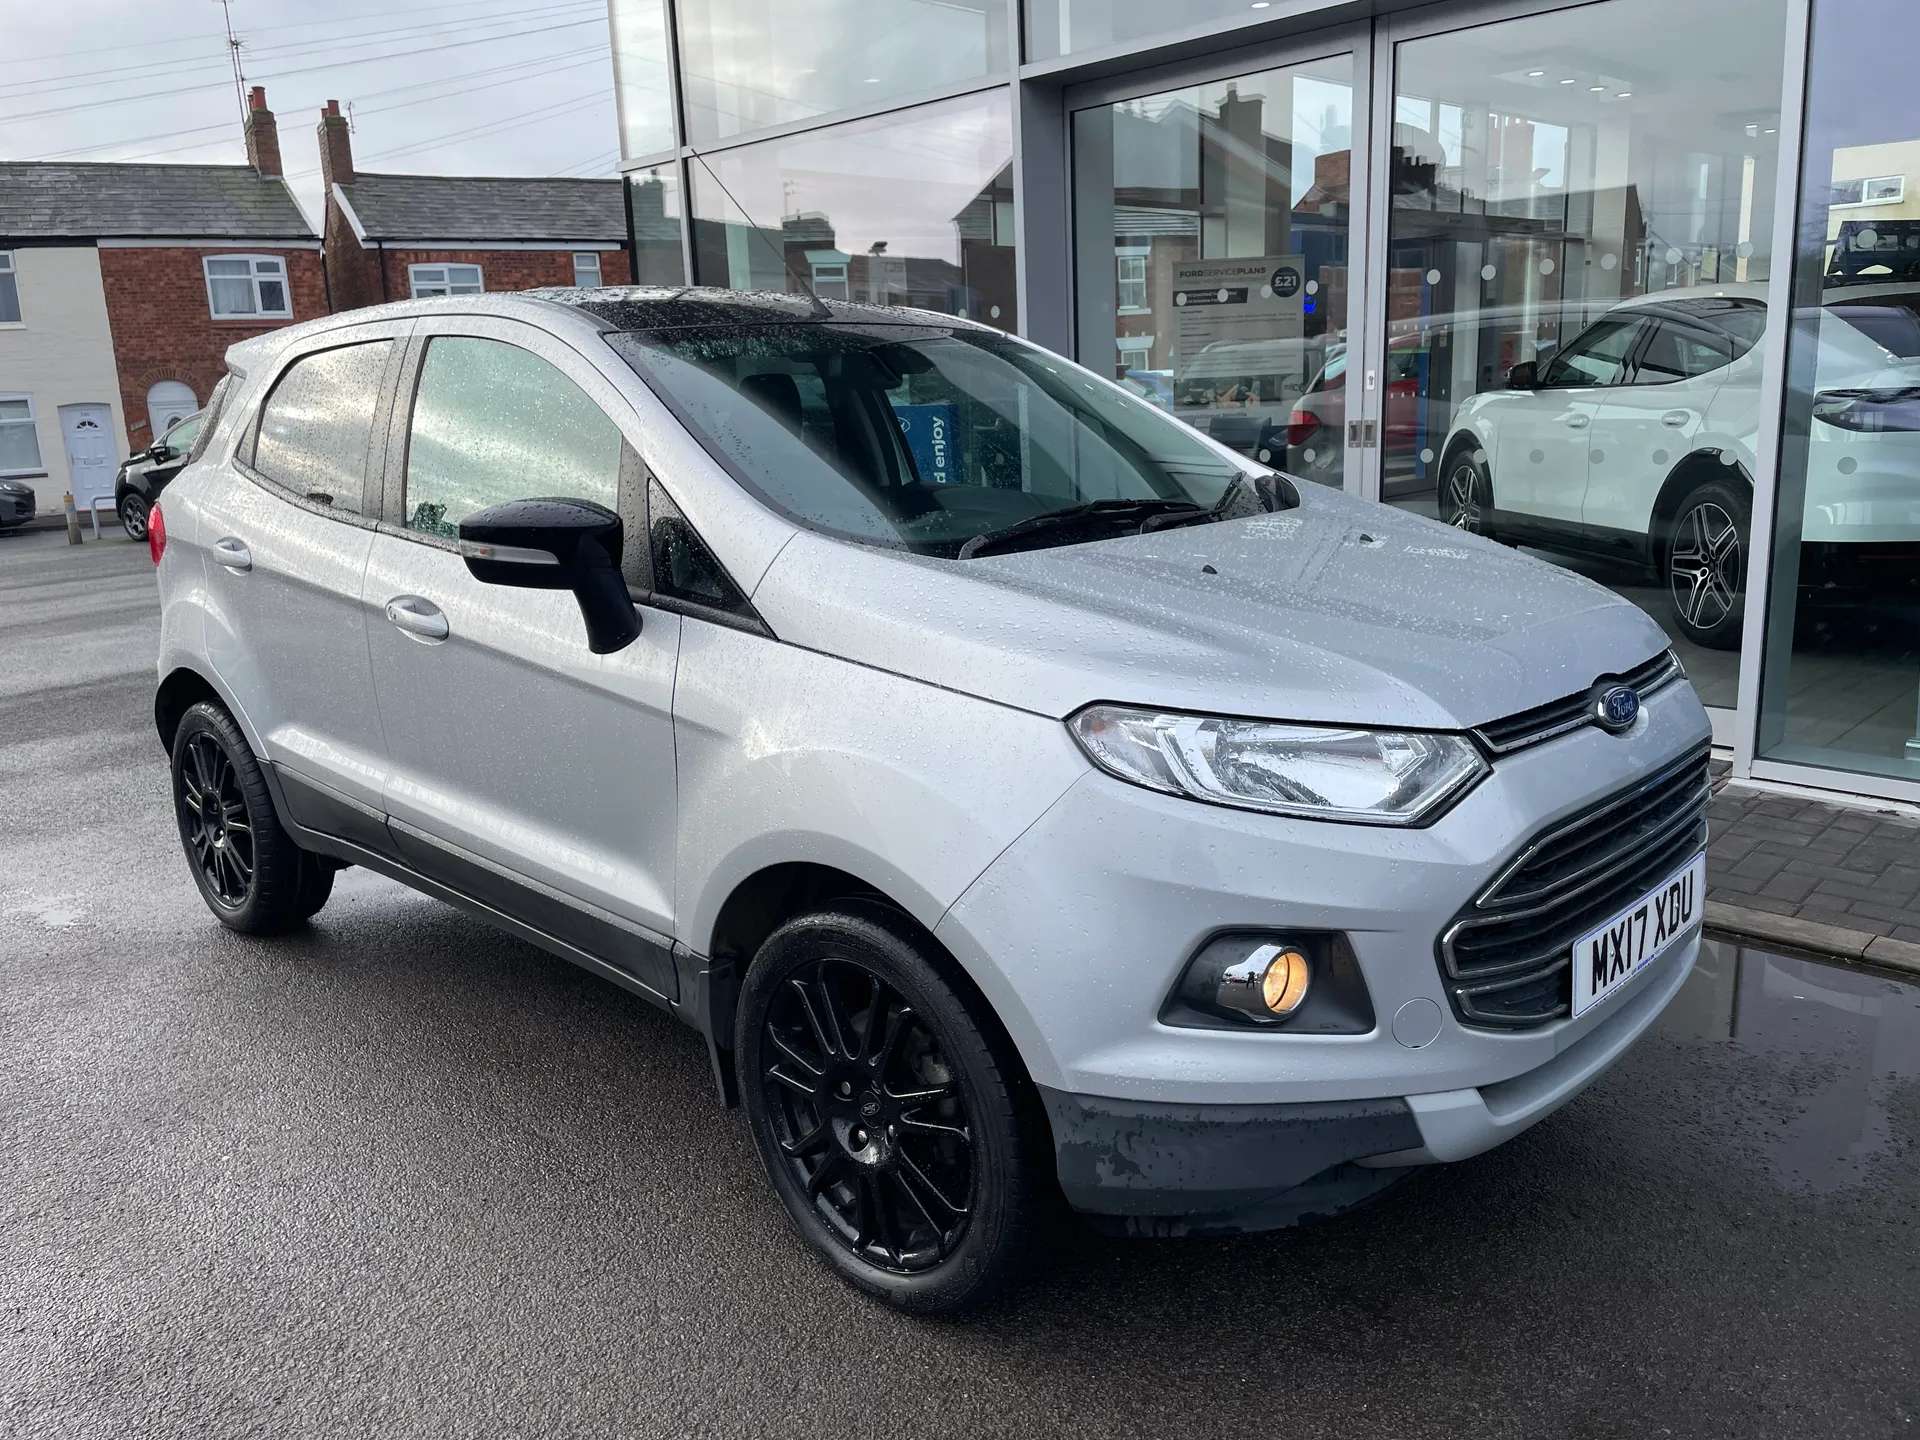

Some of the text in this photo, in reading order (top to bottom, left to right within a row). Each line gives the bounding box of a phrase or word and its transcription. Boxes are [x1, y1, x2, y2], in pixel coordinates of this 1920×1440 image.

[1274, 275, 1297, 287] £21
[932, 416, 946, 468] enjoy
[1591, 868, 1694, 996] MX17 XDU
